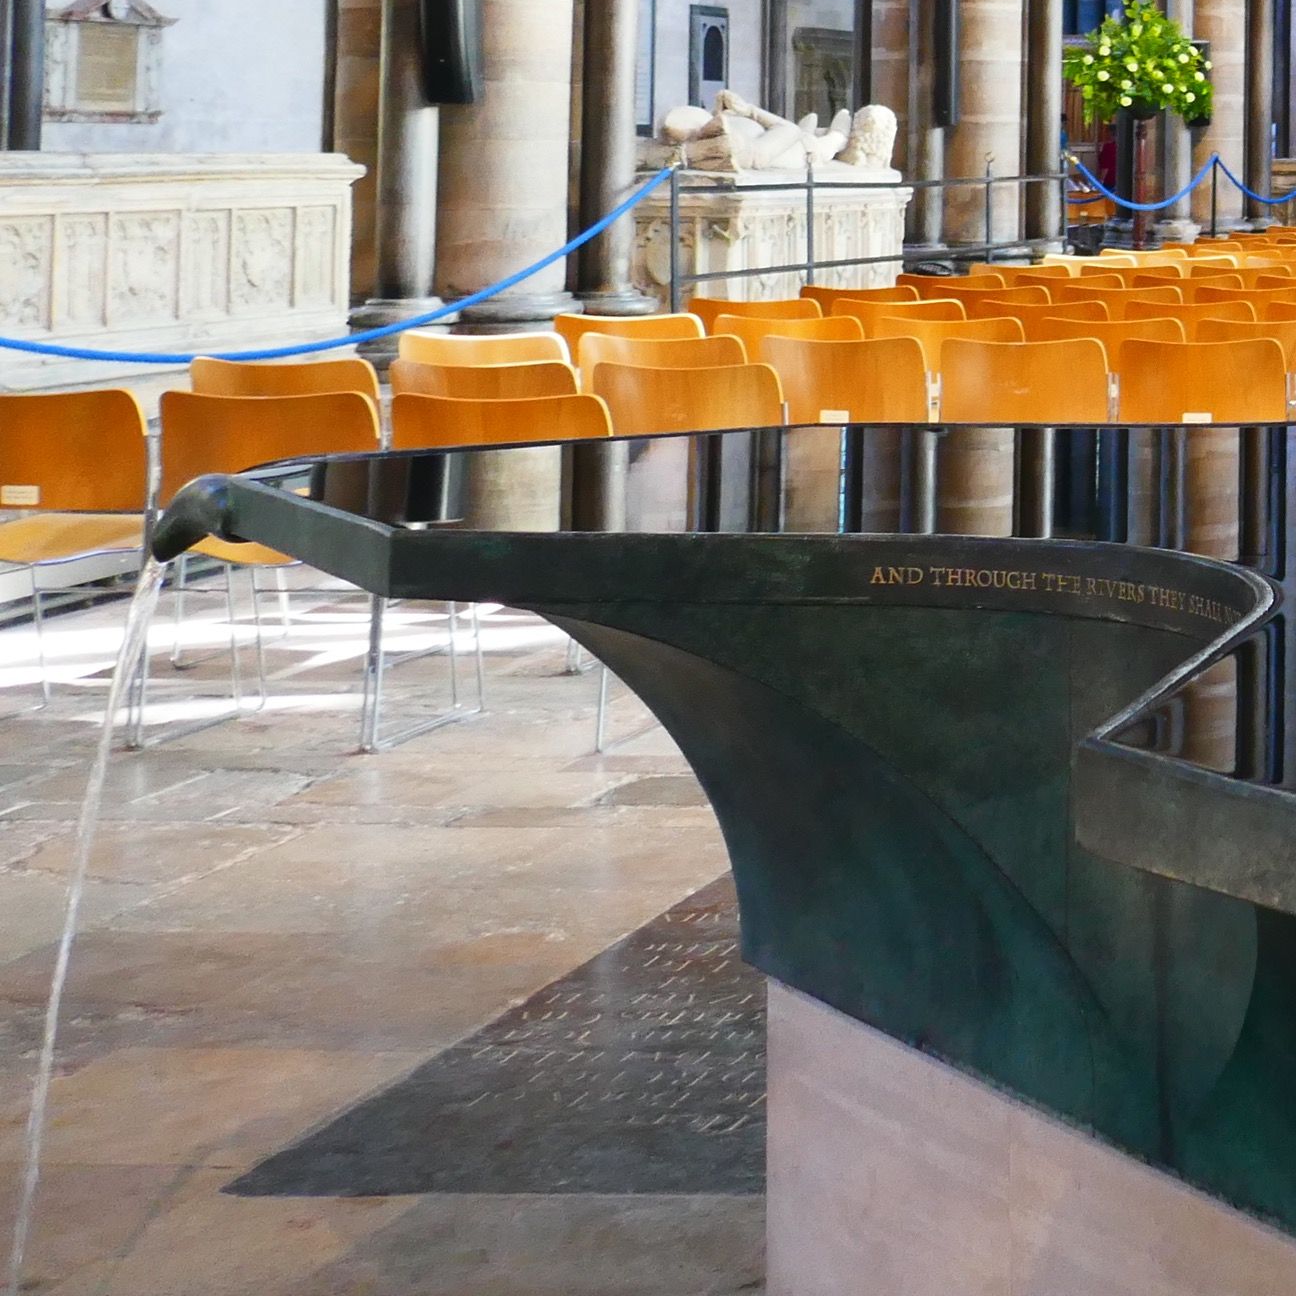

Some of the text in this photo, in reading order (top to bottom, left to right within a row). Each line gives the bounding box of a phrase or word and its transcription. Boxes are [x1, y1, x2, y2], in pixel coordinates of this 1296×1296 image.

[869, 566, 924, 585] AND
[929, 566, 1038, 591] THROUGH
[1086, 577, 1145, 604] RIVERS
[1149, 586, 1186, 611] THEY
